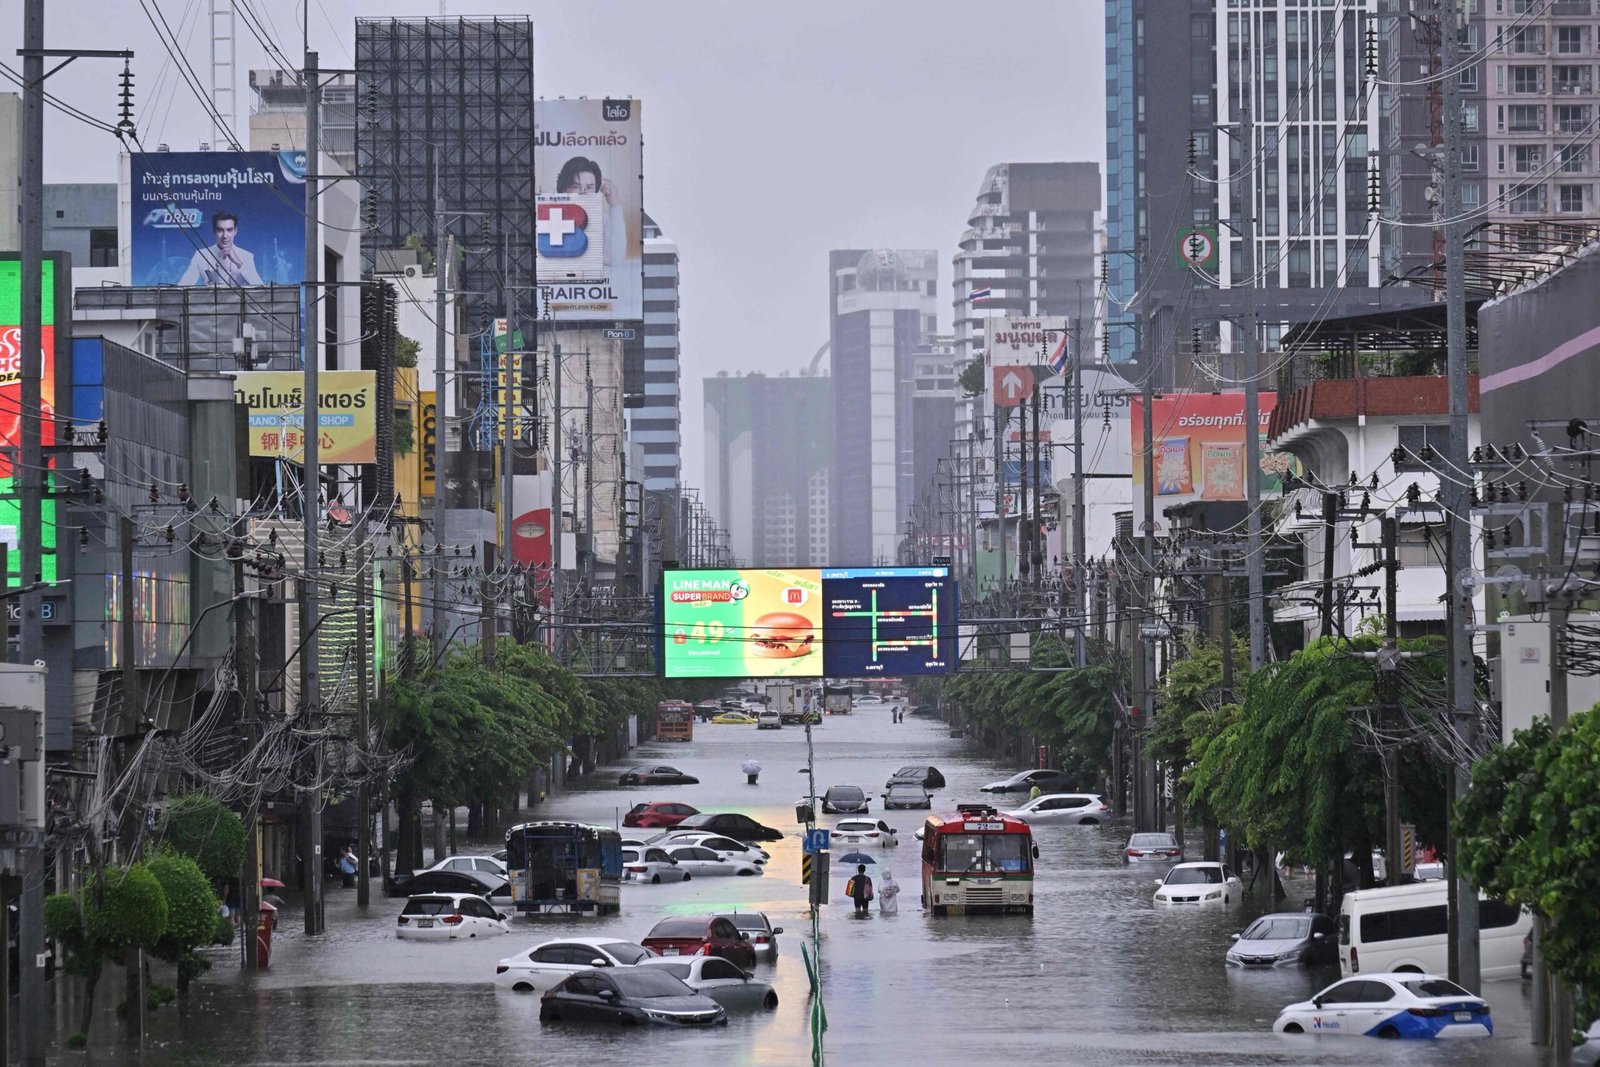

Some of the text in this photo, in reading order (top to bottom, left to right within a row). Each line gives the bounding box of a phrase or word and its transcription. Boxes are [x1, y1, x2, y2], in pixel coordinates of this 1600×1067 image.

[541, 286, 618, 300] HAIR OIL
[607, 330, 624, 338] Plan
[321, 416, 349, 425] SHOP
[260, 432, 335, 450] 钢琴心
[673, 580, 730, 589] LINE MAN
[673, 592, 731, 601] SUPER BRAND
[1322, 1020, 1341, 1030] Health
